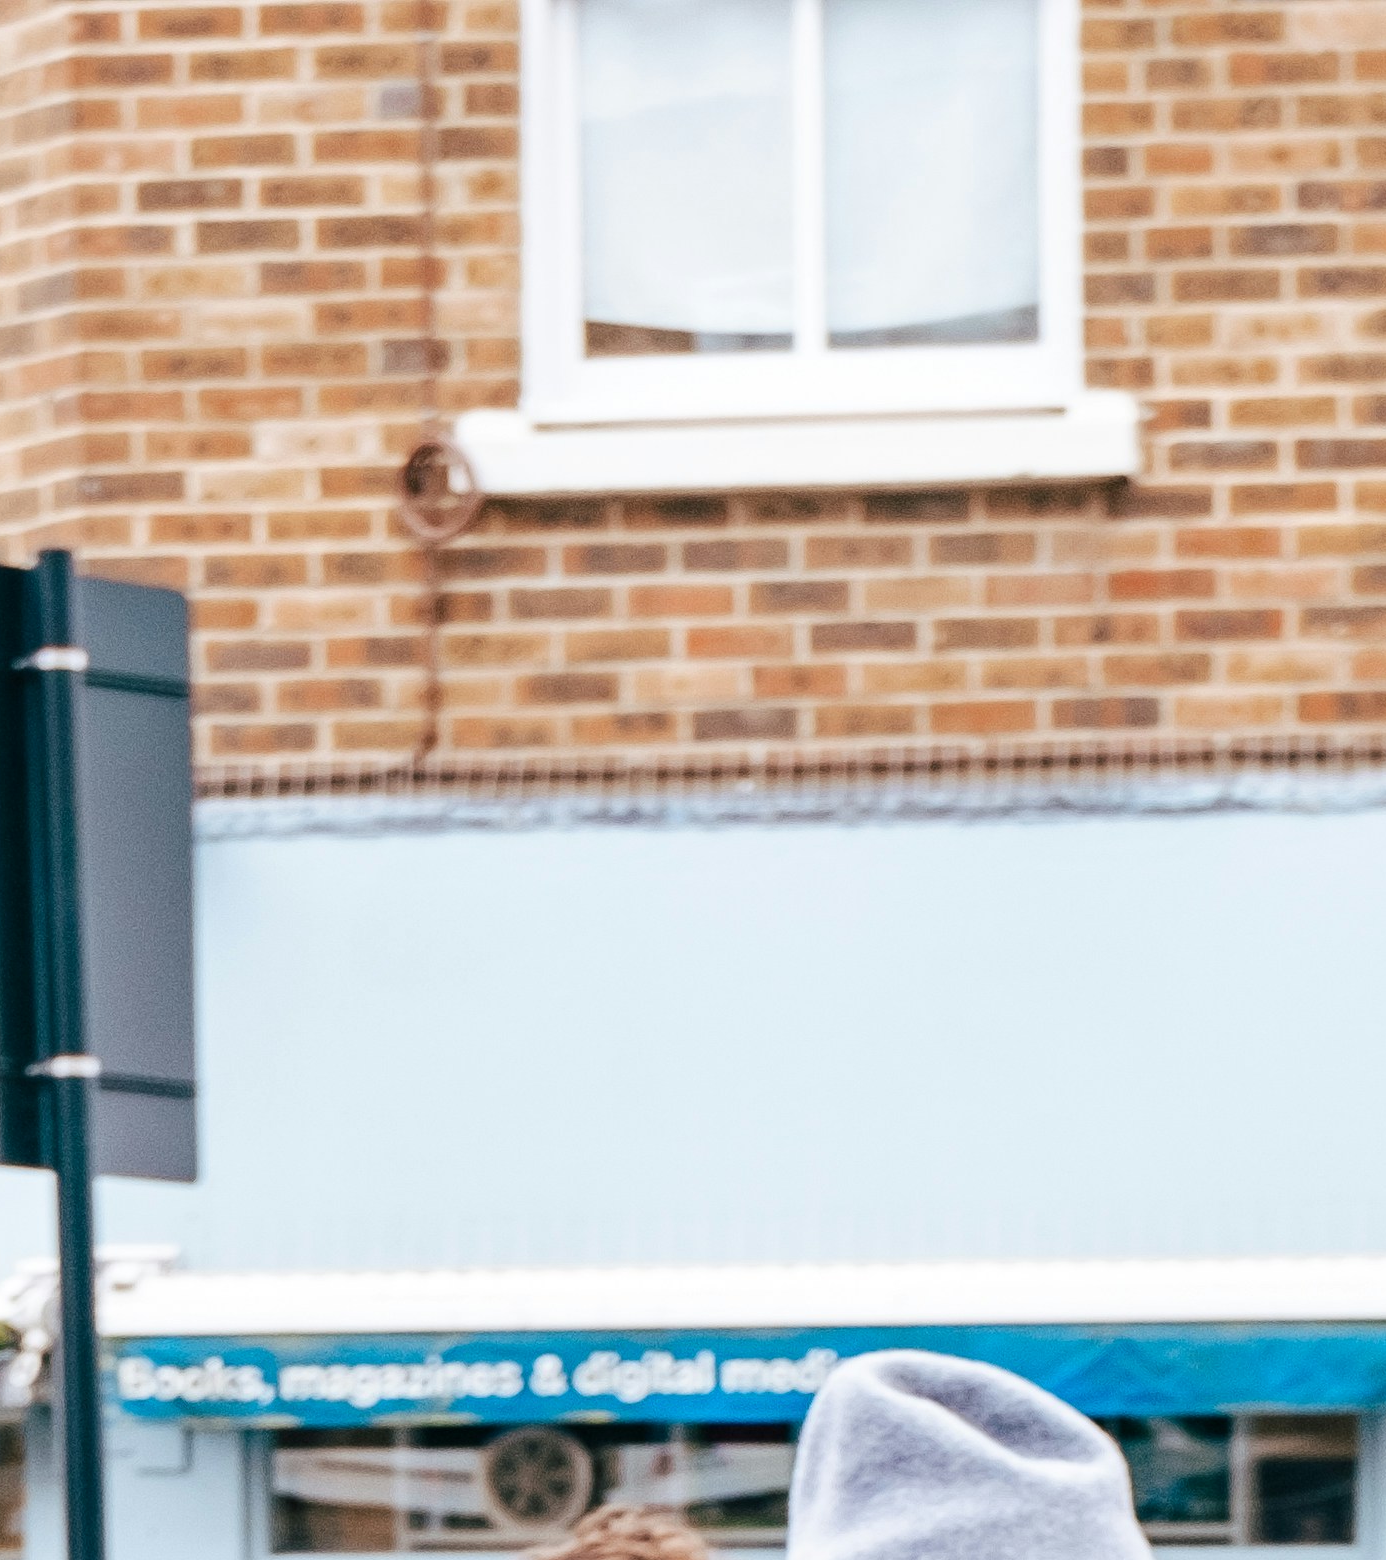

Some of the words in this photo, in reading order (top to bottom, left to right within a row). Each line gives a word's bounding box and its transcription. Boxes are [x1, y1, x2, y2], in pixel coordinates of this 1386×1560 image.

[117, 1355, 277, 1405] Books,
[278, 1356, 524, 1409] magazines
[529, 1354, 568, 1397] &
[573, 1350, 717, 1403] digital
[720, 1348, 839, 1395] medi
